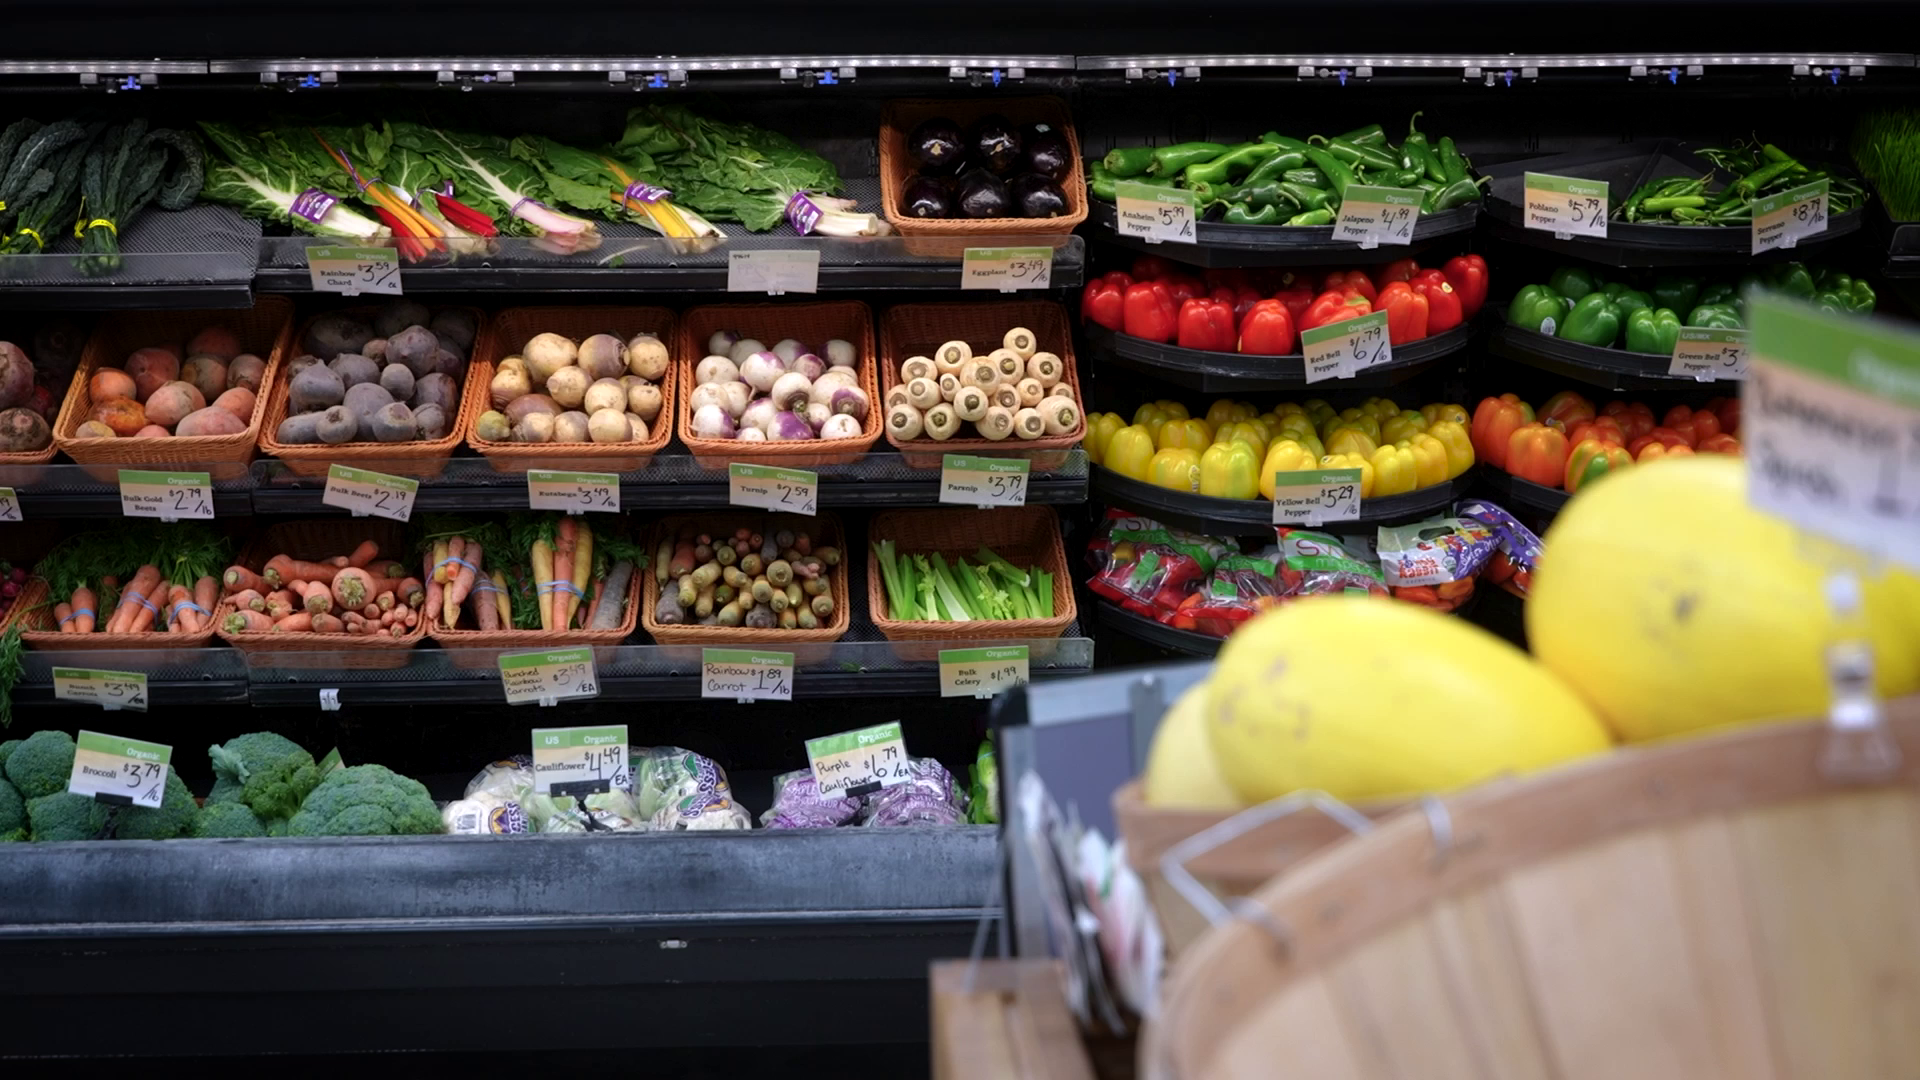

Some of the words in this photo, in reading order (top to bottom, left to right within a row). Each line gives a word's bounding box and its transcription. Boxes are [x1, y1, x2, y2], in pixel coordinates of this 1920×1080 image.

[1568, 184, 1599, 195] Organic
[1157, 193, 1187, 204] Organic
[1793, 189, 1821, 203] Organic
[1529, 203, 1559, 214] Poblano
[1568, 198, 1600, 222] $5.79
[1763, 202, 1775, 212] US
[1122, 210, 1156, 222] Anaheim
[1158, 206, 1185, 226] $5.99
[1342, 214, 1375, 225] Jalapeno
[1531, 214, 1557, 225] Pepper
[1127, 221, 1152, 233] Pepper
[1343, 226, 1369, 236] Pepper
[1757, 222, 1786, 234] Serrano
[1759, 232, 1784, 245] Pepper
[320, 270, 356, 278] Rainbow
[972, 269, 1008, 277] Eggplant
[1009, 259, 1044, 278] $3.49
[327, 279, 353, 287] Chard
[1349, 327, 1382, 360] $6.79
[1310, 355, 1325, 365] Red
[1326, 350, 1341, 361] Bell
[1678, 352, 1704, 361] Green
[1704, 352, 1721, 361] Bell
[1314, 361, 1340, 374] Pepper
[1683, 362, 1711, 371] Pepper
[953, 460, 966, 468] US
[989, 463, 1022, 472] Organic
[740, 467, 753, 475] US
[777, 472, 809, 483] Organic
[1321, 474, 1354, 484] Organic
[168, 477, 201, 487] Organic
[376, 479, 409, 489] Organic
[330, 486, 350, 495] Bulk
[350, 490, 373, 500] Beets
[740, 485, 768, 495] Turnip
[948, 483, 979, 493] Parsnip
[144, 495, 163, 503] Gold
[168, 487, 202, 511] $2.79
[373, 488, 407, 511] $2.19
[1276, 499, 1305, 507] Yellow
[1305, 497, 1321, 505] Bell
[134, 504, 157, 512] Beets
[1284, 509, 1313, 517] Pepper
[548, 652, 582, 662] Organic
[986, 649, 1020, 659] Organic
[751, 656, 785, 665] Organic
[504, 667, 539, 678] Bunched
[703, 662, 750, 676] Rainbow
[958, 669, 977, 677] Bulk
[990, 666, 1017, 681] $1.99
[504, 678, 543, 687] Rainbow
[575, 680, 597, 693] /EA
[707, 679, 747, 693] Carrot
[771, 679, 791, 694] /lb
[955, 678, 981, 687] Celery
[507, 685, 546, 696] Carrots
[545, 737, 560, 745] US
[584, 735, 618, 745] Organic
[857, 730, 894, 744] Organic
[126, 747, 161, 761] Organic
[535, 762, 586, 772] Cauliflower
[584, 747, 622, 780] $4.49
[816, 758, 852, 776] Purple
[864, 746, 898, 778] $6.79
[82, 766, 117, 779] Broccoli
[123, 762, 162, 788] $3.79
[610, 765, 629, 786] /EA
[819, 774, 873, 794] Cauliflower
